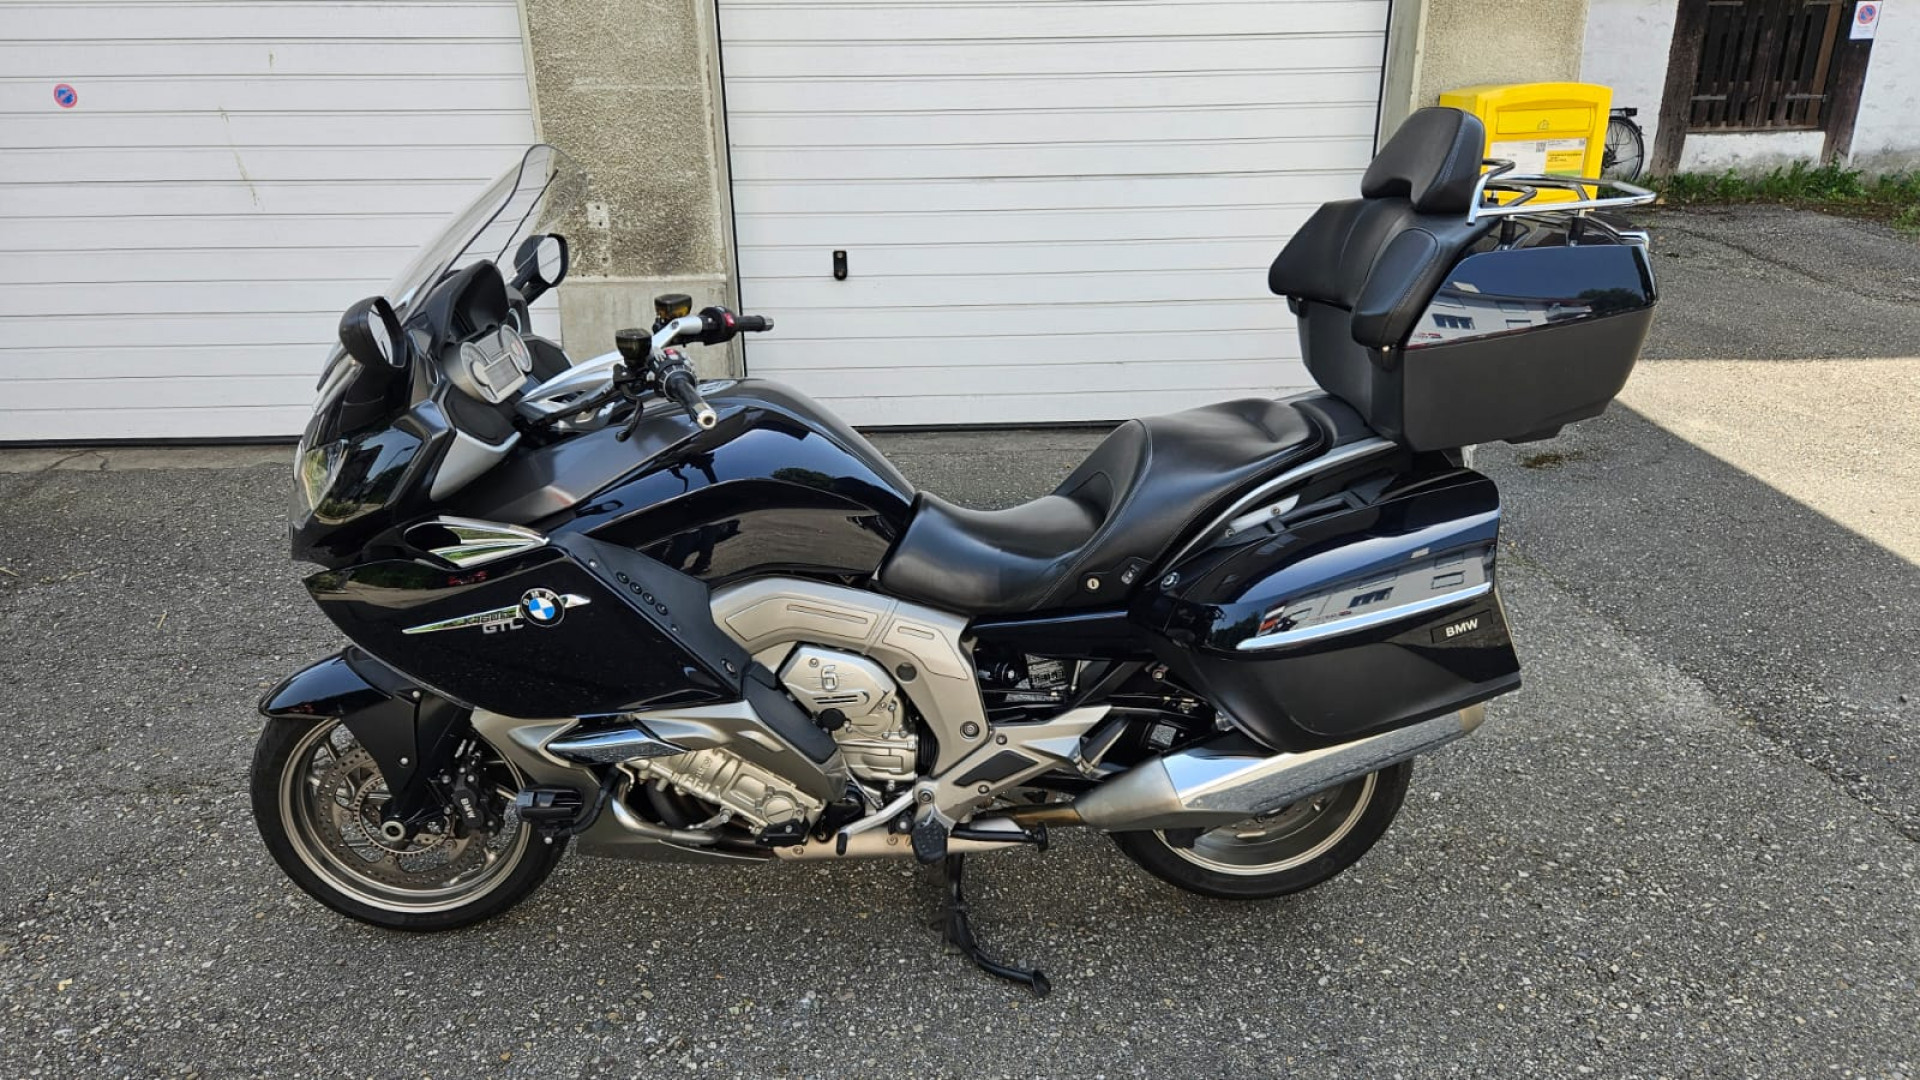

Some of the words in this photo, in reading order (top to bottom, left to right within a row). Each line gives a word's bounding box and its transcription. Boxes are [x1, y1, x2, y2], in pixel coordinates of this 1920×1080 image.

[1445, 618, 1478, 637] BMW
[821, 664, 838, 691] 6
[460, 797, 476, 818] BMW
